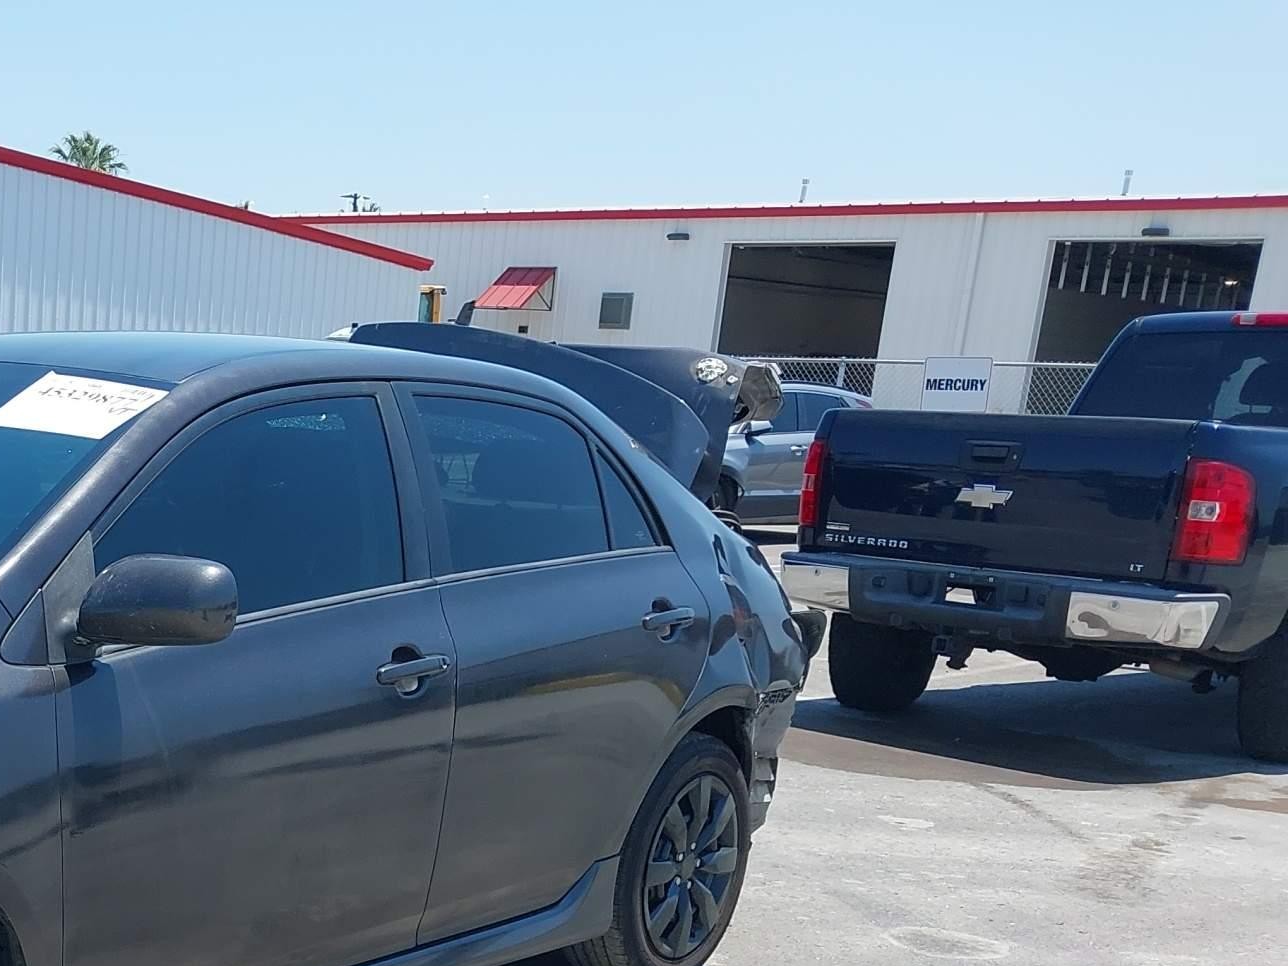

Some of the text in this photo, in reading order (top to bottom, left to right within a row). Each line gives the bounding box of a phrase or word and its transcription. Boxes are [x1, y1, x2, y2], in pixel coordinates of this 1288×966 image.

[925, 378, 988, 391] MERCURY
[824, 533, 909, 549] SILVERADO
[1129, 563, 1145, 572] LT
